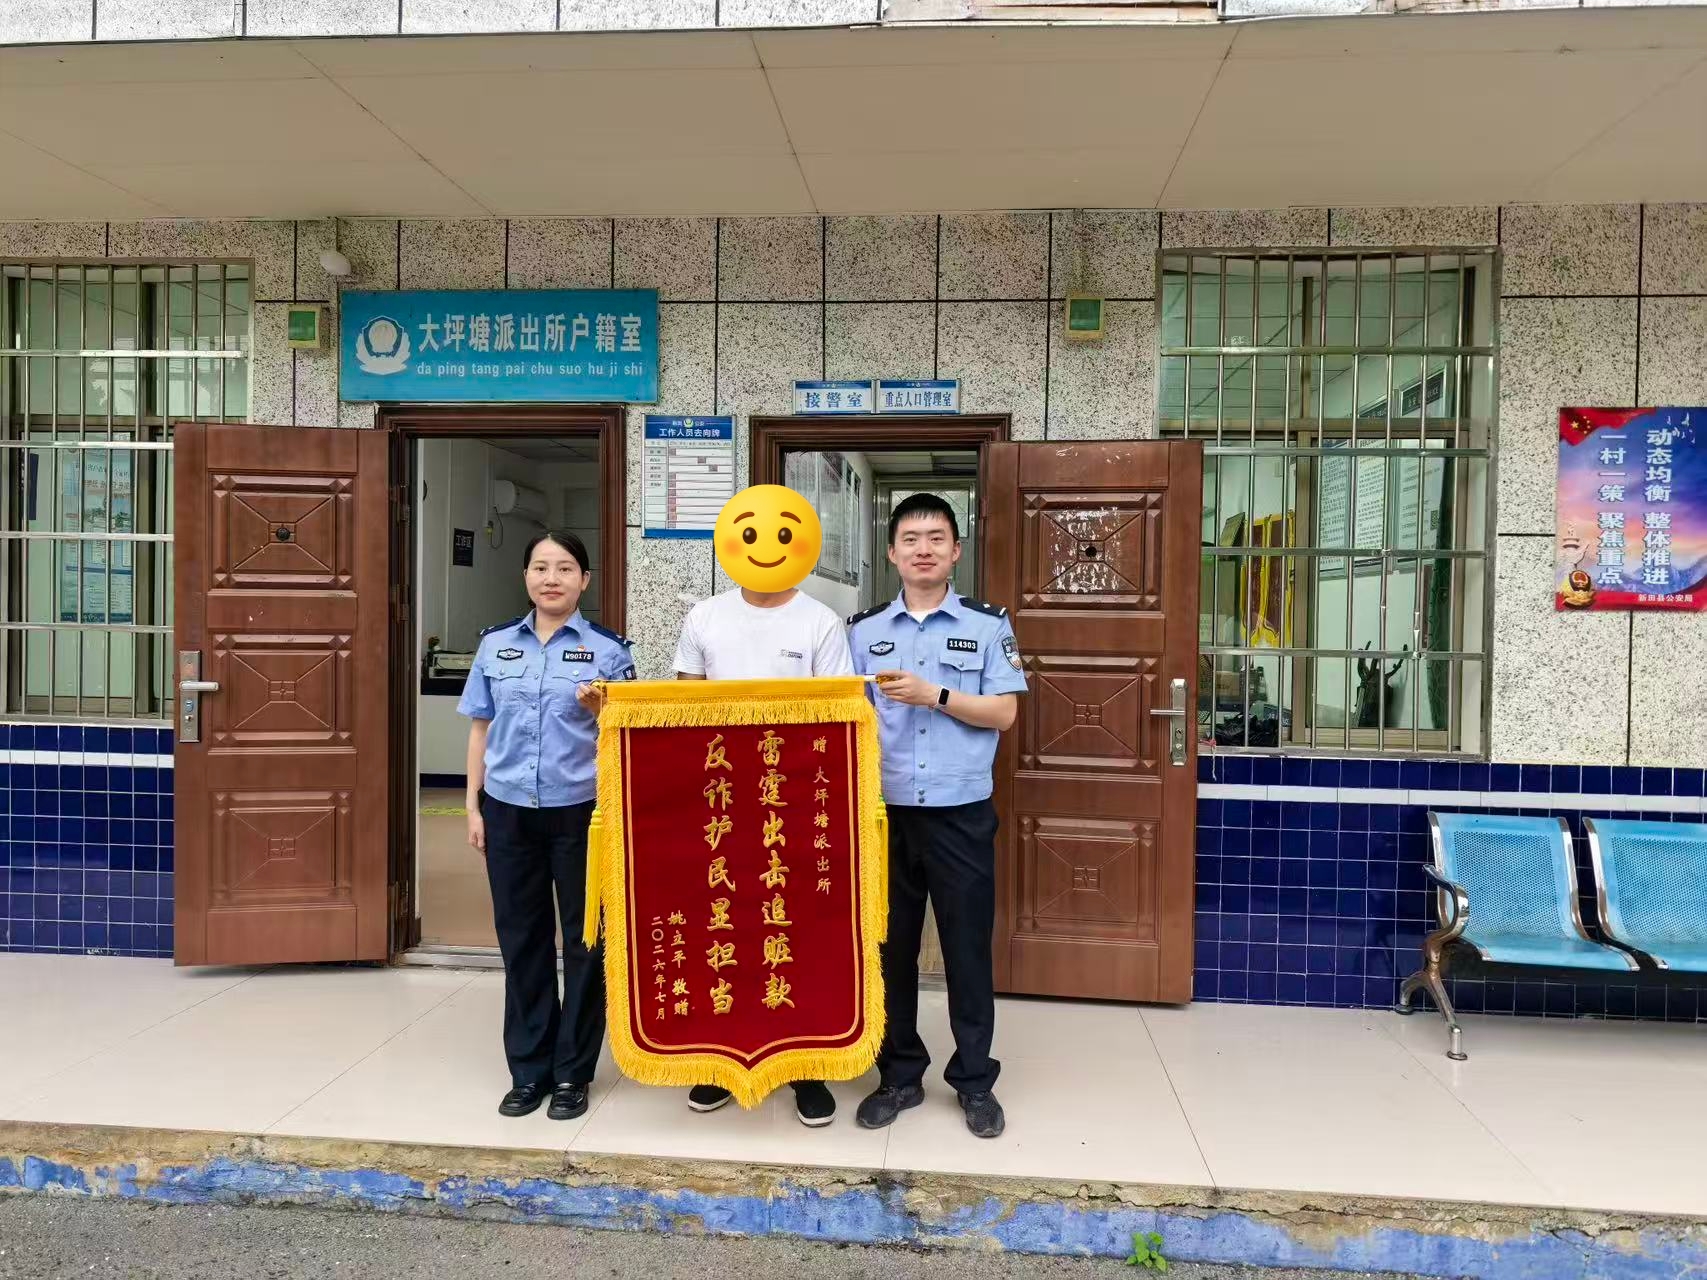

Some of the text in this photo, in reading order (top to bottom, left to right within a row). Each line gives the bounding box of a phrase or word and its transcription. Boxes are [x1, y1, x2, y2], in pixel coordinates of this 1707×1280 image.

[417, 312, 642, 353] 大坪塘派出所户籍室
[417, 363, 643, 377] da ping tang pai chu suo hu ji shi
[805, 391, 863, 408] 接警室
[885, 391, 952, 408] 重点人口管理室
[659, 428, 720, 438] 工作人员去向牌
[1597, 434, 1627, 585] 一村一策 聚焦重点
[1642, 428, 1673, 585] 动态均衡 整体推进
[949, 640, 977, 650] 114303
[812, 735, 827, 753] 赠
[703, 733, 738, 1016] 反诈护民显担当
[757, 730, 795, 1010] 雷霆出击追赃款
[667, 909, 691, 1017] 姚立平 敬赠
